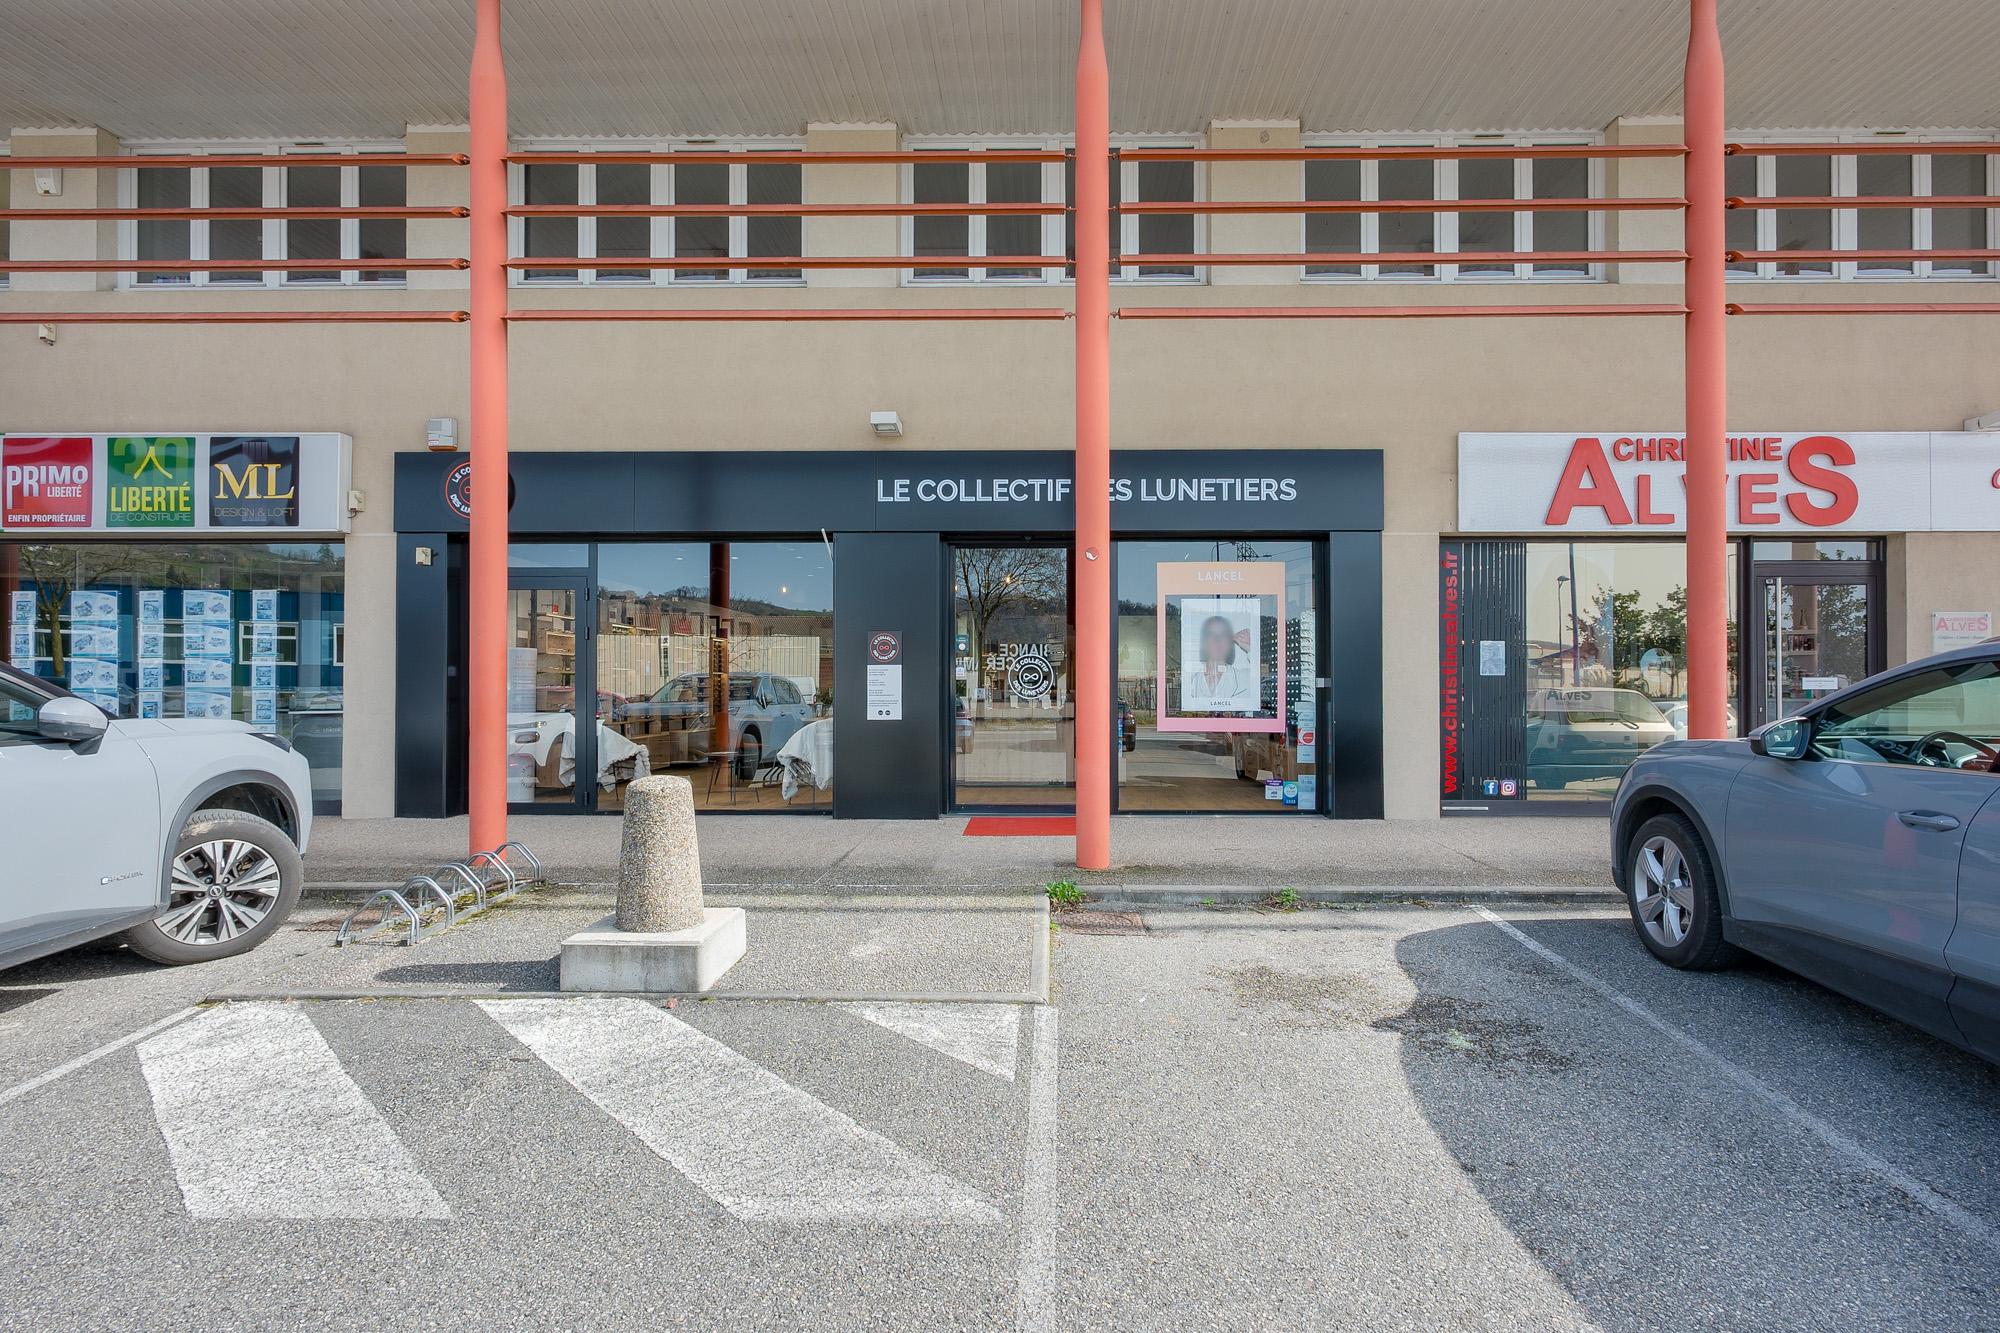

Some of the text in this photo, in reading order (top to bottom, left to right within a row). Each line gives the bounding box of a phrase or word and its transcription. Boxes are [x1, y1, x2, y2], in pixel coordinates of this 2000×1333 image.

[1612, 437, 1783, 461] CHRIINE
[214, 463, 295, 499] ML
[451, 472, 462, 482] LE
[1545, 436, 1858, 526] ALES
[6, 465, 89, 510] PRIMO
[47, 483, 82, 498] LIBERTÉ
[877, 479, 910, 501] LE
[917, 479, 1071, 502] COLLECTIF
[1140, 478, 1297, 501] LUNETIERS
[111, 481, 191, 512] LIBERTÉ
[450, 494, 462, 507] DES
[8, 512, 86, 522] ENFIN PROPRIÉTAIRE
[110, 512, 191, 522] DE CONSTRUIRE
[214, 507, 295, 517] DESIGN & LOFT
[1197, 571, 1245, 581] LANCEL
[1013, 657, 1049, 673] LE COLLECTIF
[1440, 551, 1458, 793] www.christinealves.fr
[1012, 680, 1049, 696] DES LUNETIERS
